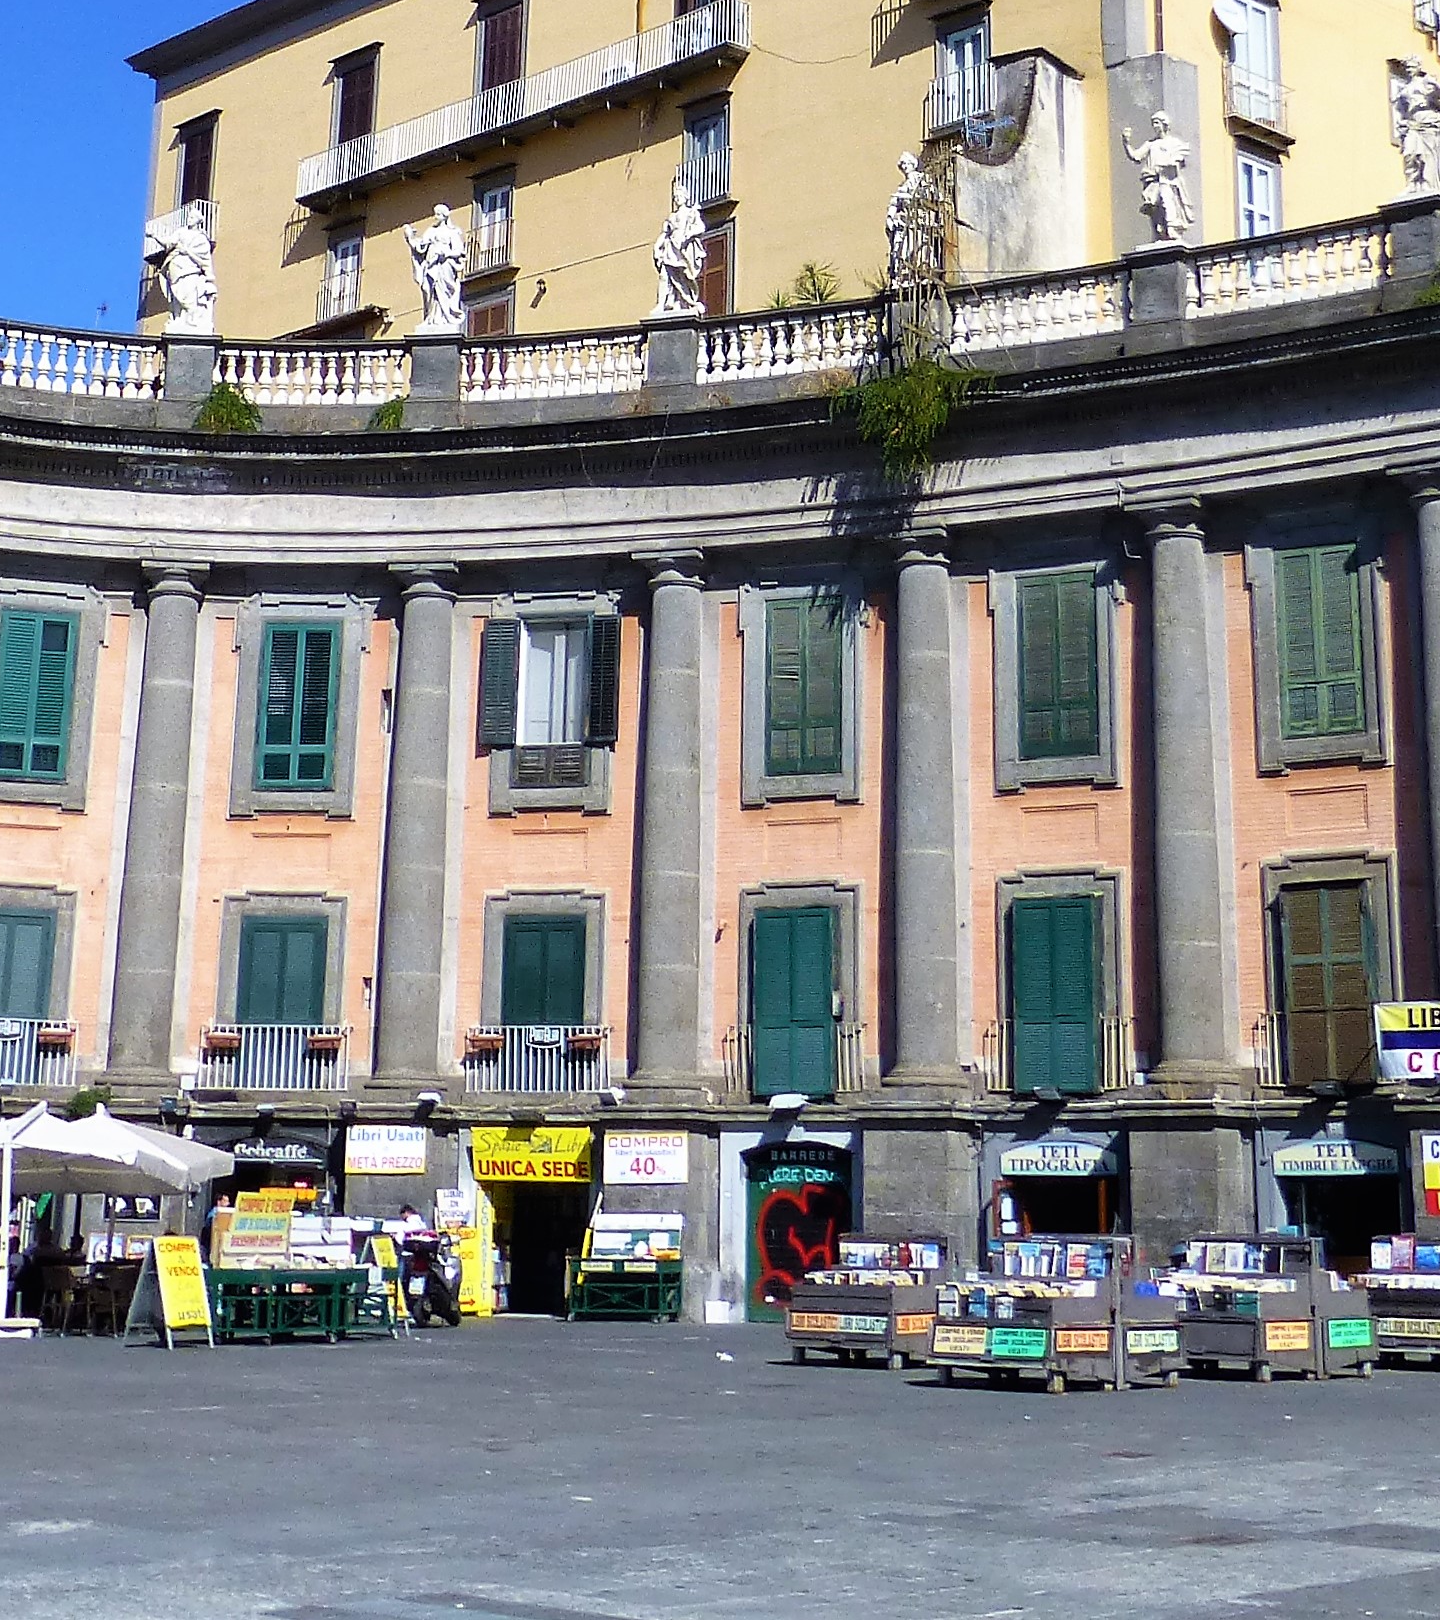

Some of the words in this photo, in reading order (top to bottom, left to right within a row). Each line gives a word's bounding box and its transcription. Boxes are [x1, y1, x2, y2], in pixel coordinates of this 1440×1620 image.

[348, 1128, 381, 1141] Libri
[387, 1128, 424, 1141] Usati
[608, 1136, 683, 1148] COMPRO
[1038, 1145, 1080, 1158] TETI
[1313, 1143, 1357, 1158] TETI
[381, 1155, 423, 1169] PREZZO
[1008, 1159, 1110, 1172] TIPOGRAFIA
[1281, 1159, 1326, 1171] TIMBRI
[478, 1159, 537, 1177] UNICA
[542, 1160, 589, 1179] SEDE
